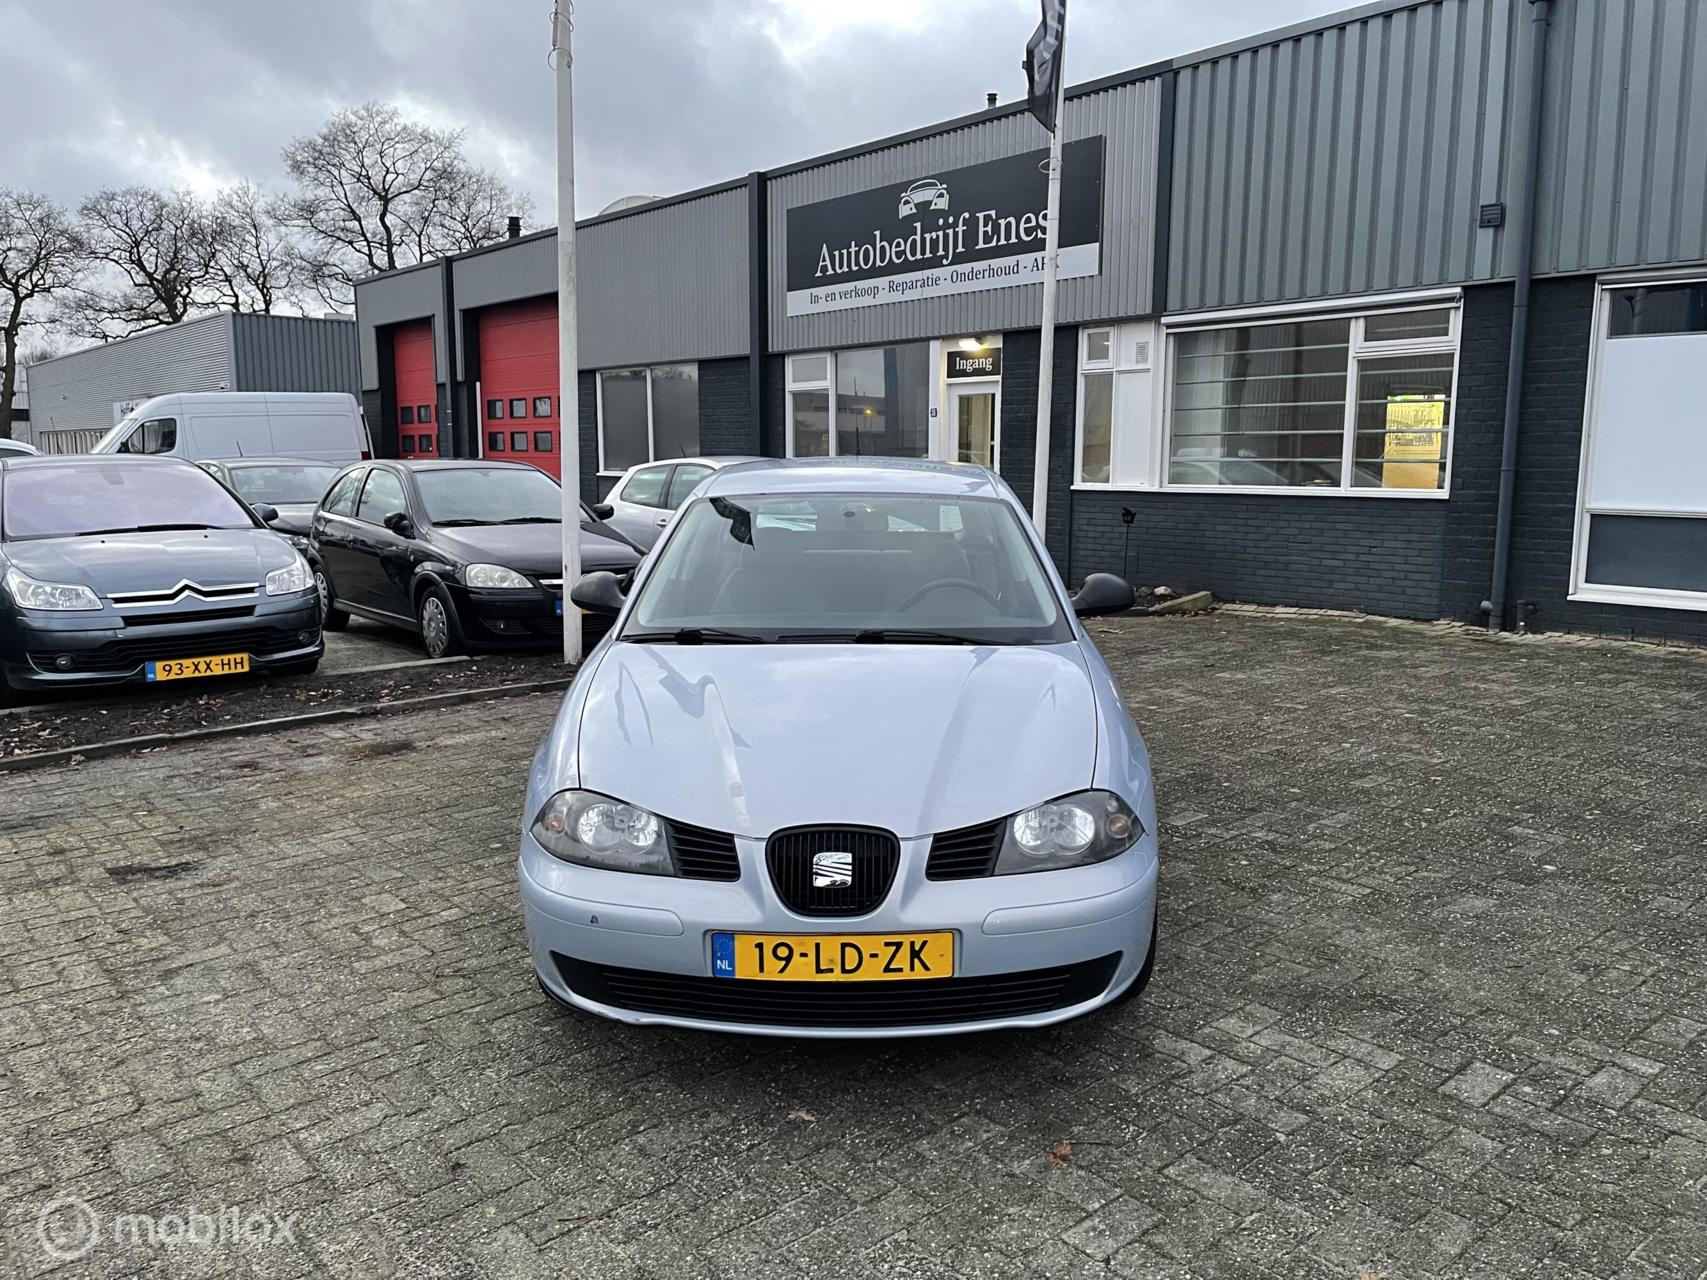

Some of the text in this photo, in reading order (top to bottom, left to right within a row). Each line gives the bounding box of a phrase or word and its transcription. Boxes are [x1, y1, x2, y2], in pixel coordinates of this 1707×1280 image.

[814, 208, 1049, 277] Autobedrijf Enes
[824, 291, 836, 302] en
[838, 285, 879, 299] verkoop
[888, 273, 941, 294] Reparatie
[950, 259, 1019, 283] Onderhoud
[956, 357, 993, 372] Ingang
[162, 656, 245, 677] 93-XX-HH
[717, 959, 733, 971] NL
[754, 939, 931, 975] 19-LD-ZK
